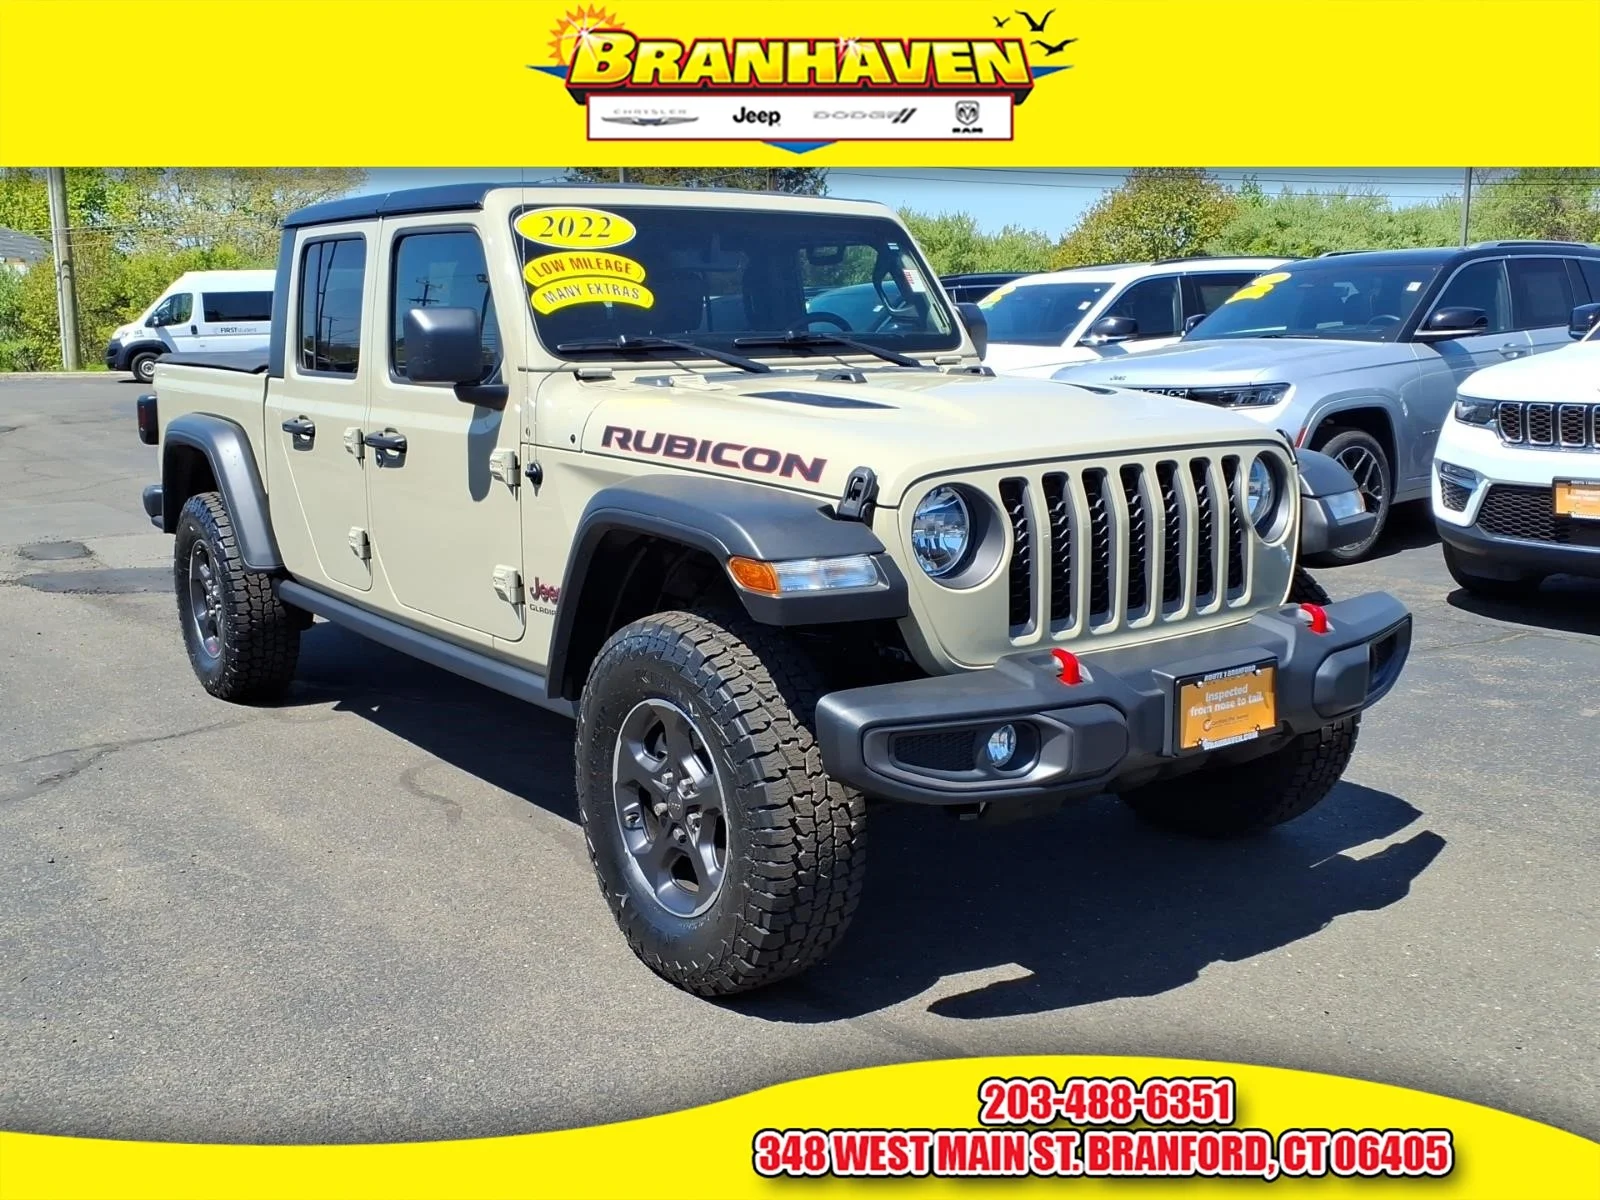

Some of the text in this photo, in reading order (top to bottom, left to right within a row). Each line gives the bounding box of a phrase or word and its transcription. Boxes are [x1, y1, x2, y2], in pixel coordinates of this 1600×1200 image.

[538, 215, 612, 239] 2022
[531, 256, 633, 278] LOW MILEAGE
[541, 282, 641, 305] MANY EXTRAS
[600, 424, 828, 483] RUBICON
[529, 603, 558, 616] GLADIA
[1206, 684, 1248, 702] Inspected
[1192, 704, 1212, 716] from
[1215, 701, 1236, 711] nose
